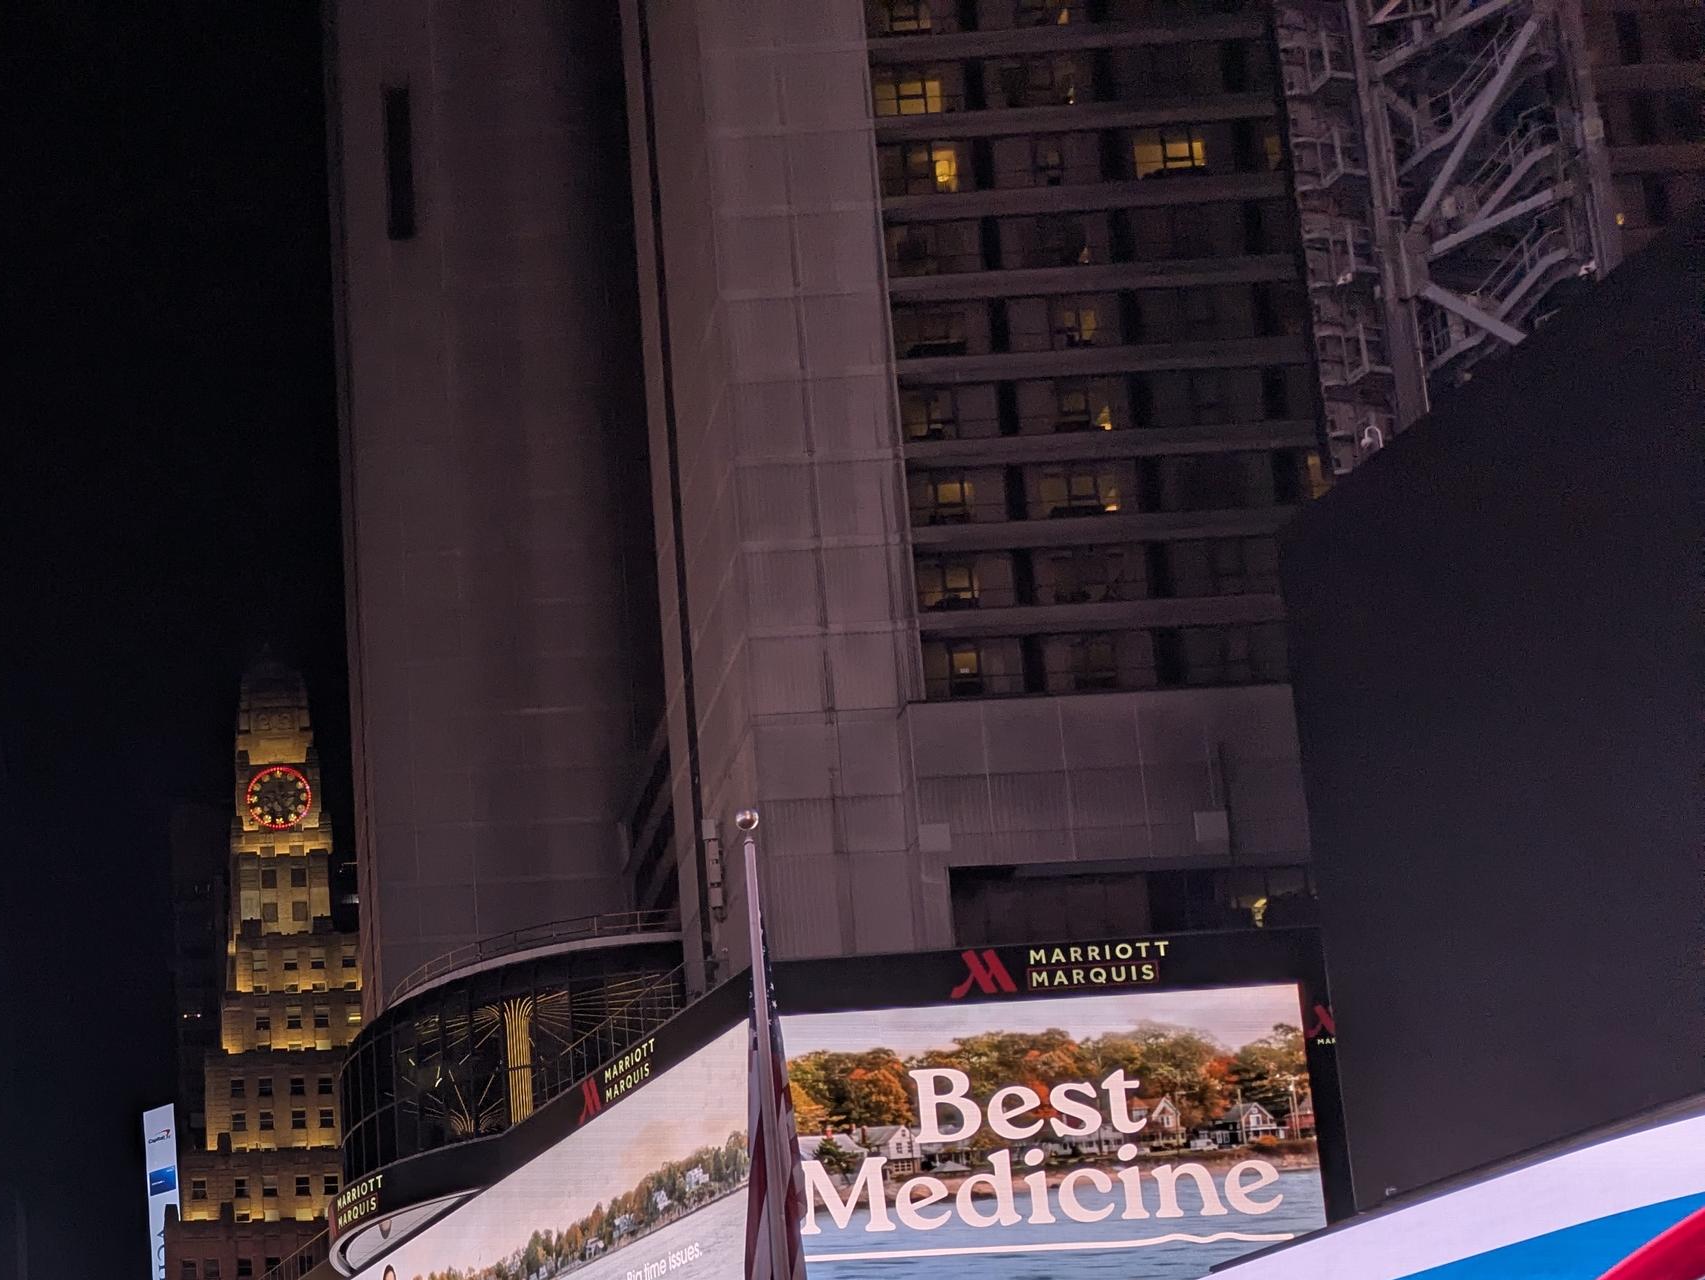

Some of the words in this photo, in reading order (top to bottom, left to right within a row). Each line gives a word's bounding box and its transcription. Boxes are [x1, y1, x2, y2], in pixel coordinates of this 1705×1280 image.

[1029, 941, 1169, 964] MARRIOTT
[1031, 963, 1155, 988] MARQUIS
[604, 1038, 656, 1083] MARRIOTT
[605, 1063, 651, 1103] MARQUIS
[908, 1067, 1148, 1145] Best
[337, 1174, 383, 1211] MARRIOTT
[800, 1143, 1284, 1236] Medicine
[337, 1197, 377, 1230] MARQUIS
[668, 1241, 703, 1273] issues.
